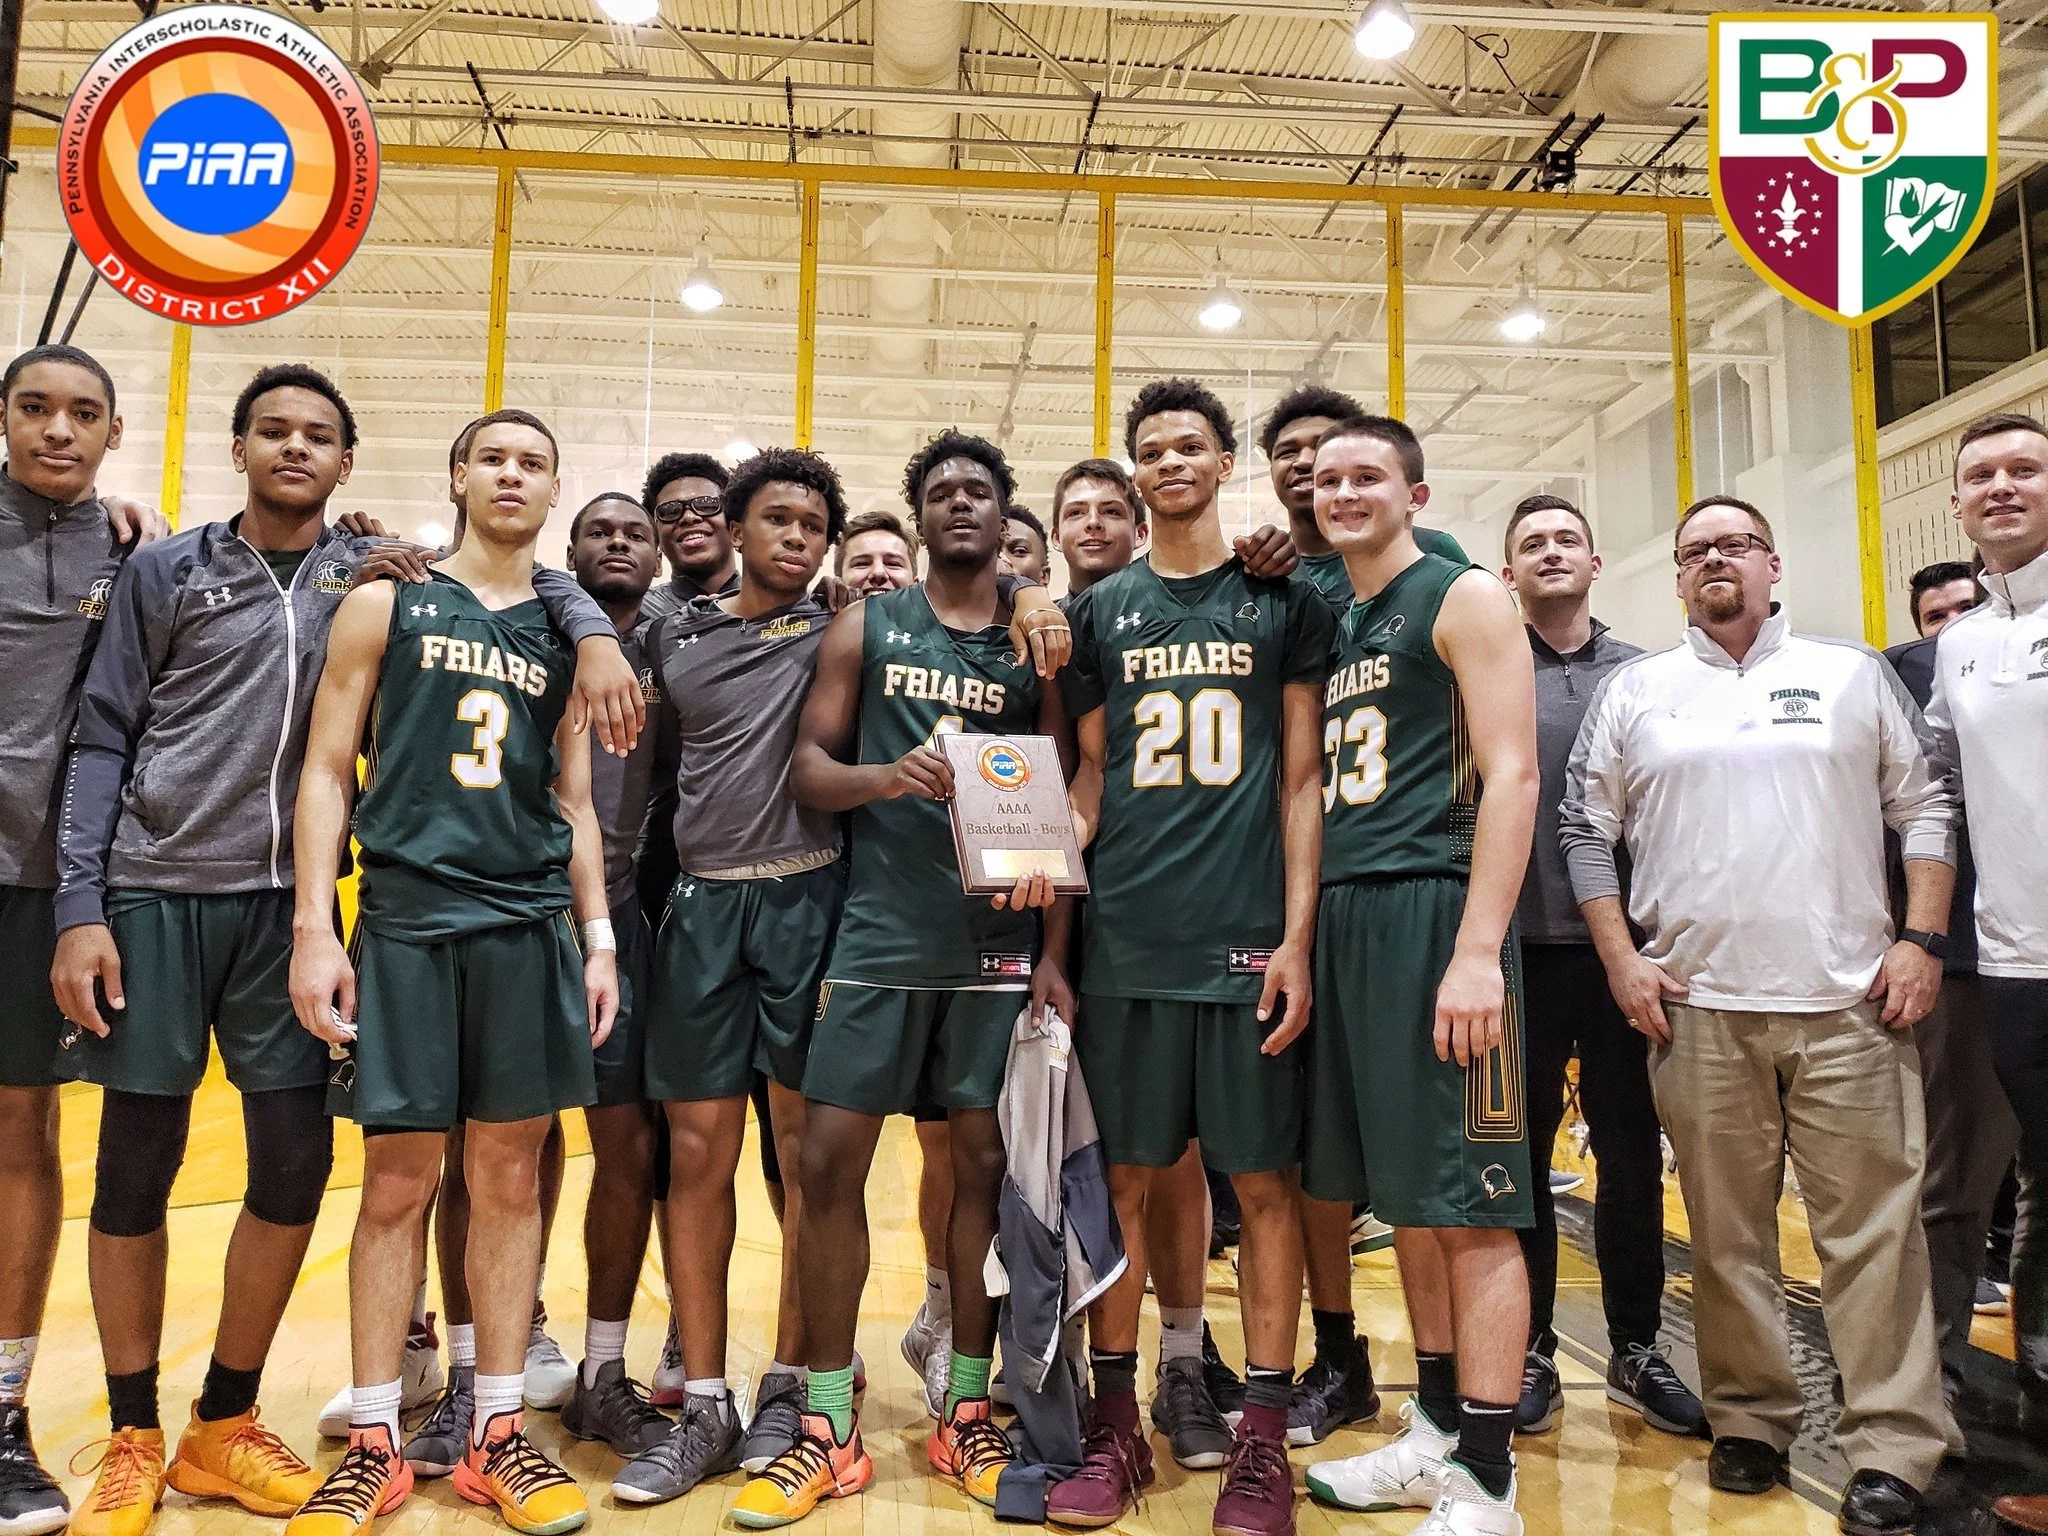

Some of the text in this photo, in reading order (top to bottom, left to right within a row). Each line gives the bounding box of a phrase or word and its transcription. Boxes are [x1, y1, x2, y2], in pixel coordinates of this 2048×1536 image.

[760, 621, 811, 640] FRIARS
[420, 634, 548, 698] FRIARS
[1122, 641, 1253, 683] FRIARS
[884, 663, 1006, 715] FRIARS
[1769, 688, 1821, 702] FRIARS
[451, 688, 510, 789] 3
[1133, 687, 1243, 788] 20
[997, 803, 1032, 815] AAAA
[966, 823, 1031, 835] Basketball
[1040, 824, 1070, 838] Boys
